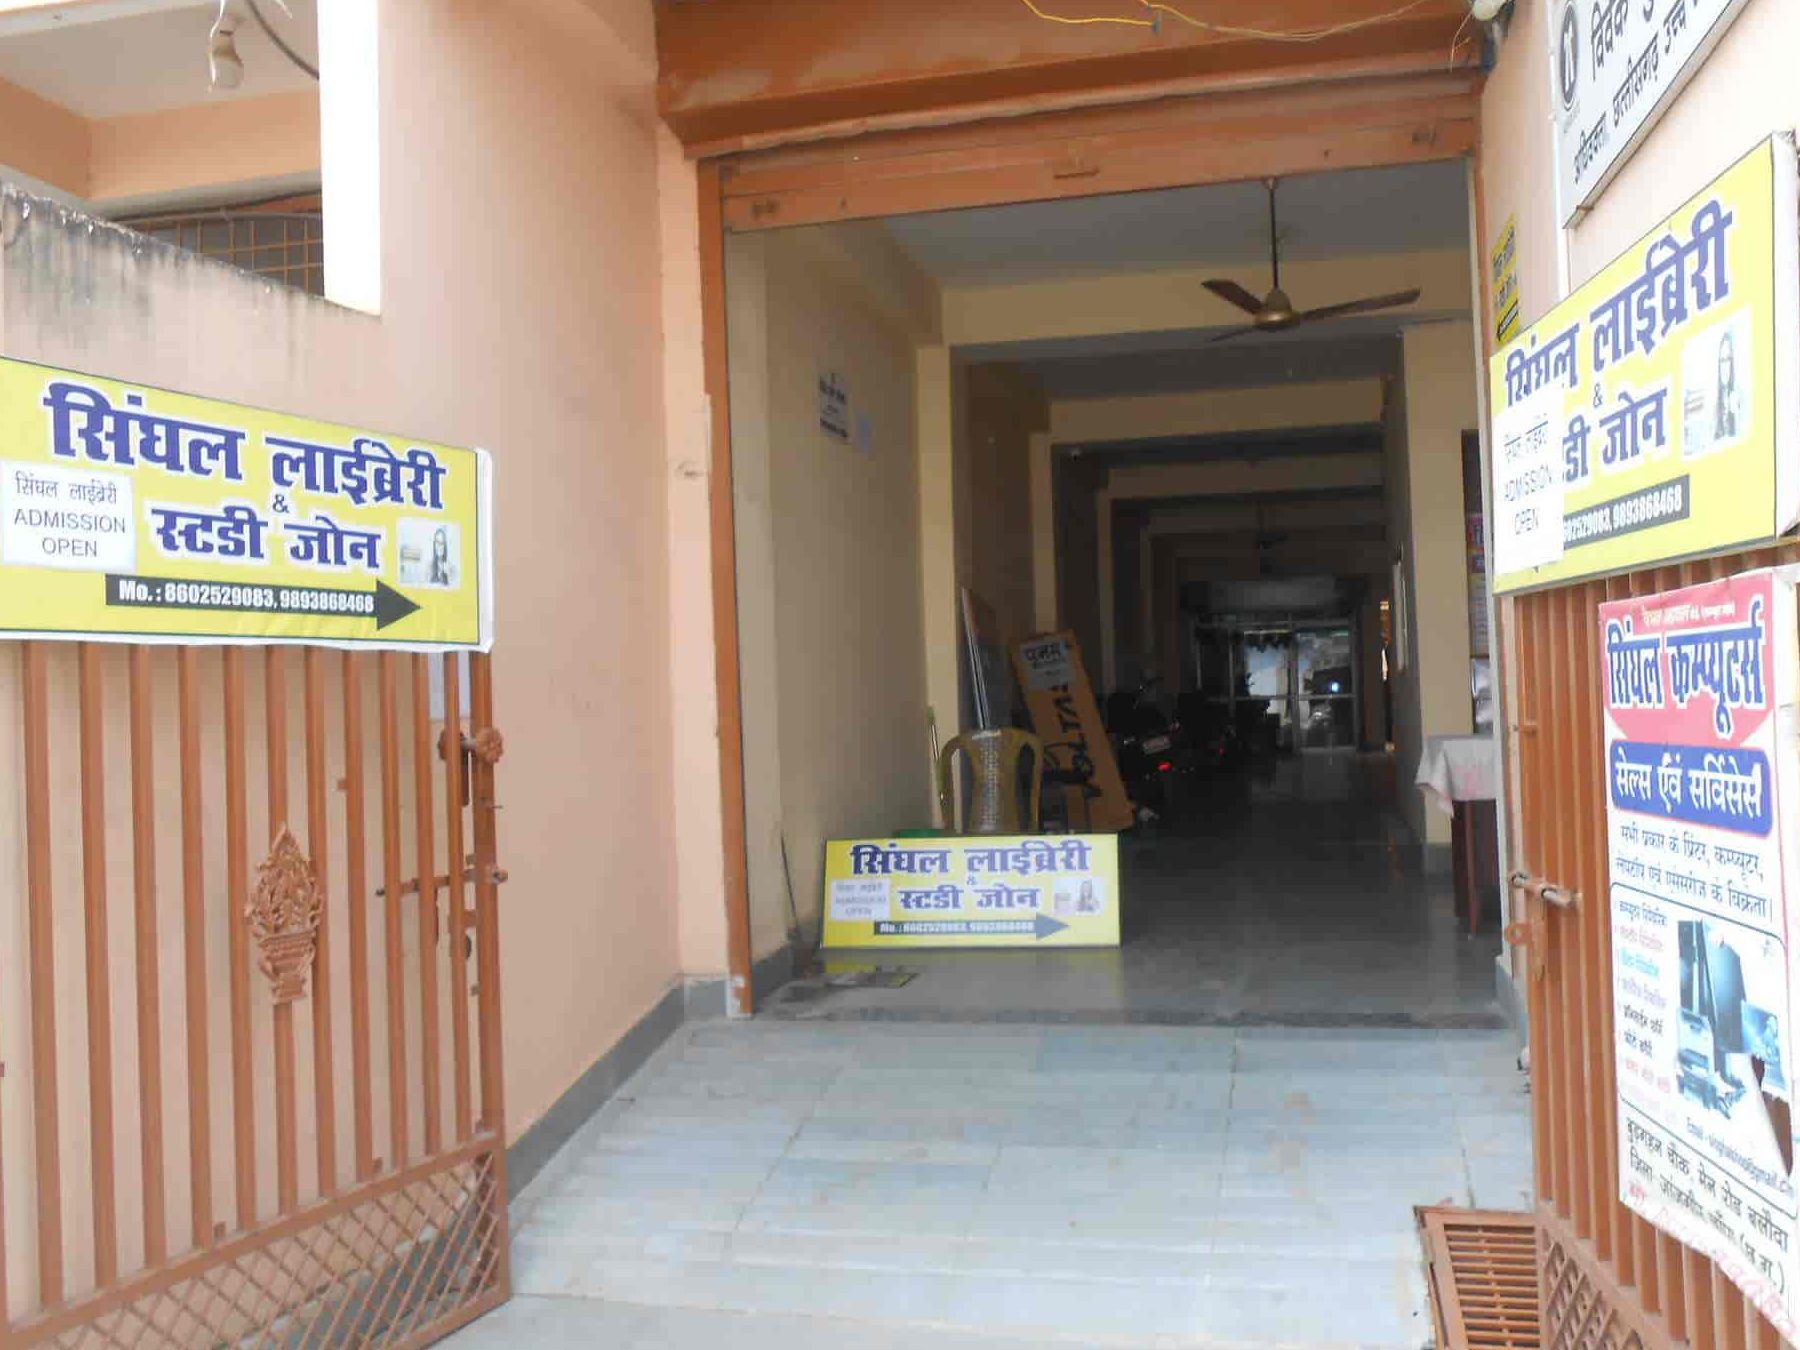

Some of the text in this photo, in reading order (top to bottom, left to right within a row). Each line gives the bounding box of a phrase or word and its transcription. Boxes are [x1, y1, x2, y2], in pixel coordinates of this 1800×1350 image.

[1592, 383, 1603, 408] &
[43, 382, 246, 480] सिंघल
[1599, 386, 1668, 466] जोन
[15, 470, 59, 497] सिंघल
[272, 493, 290, 514] &
[14, 509, 126, 533] ADMISSION
[42, 537, 98, 557] OPEN
[151, 505, 381, 569] स्टडी जोन
[1607, 619, 1664, 705] सिंघल
[1615, 747, 1652, 800] सेल्स
[850, 843, 952, 875] सिंघल
[897, 884, 1041, 910] स्टडी जोन
